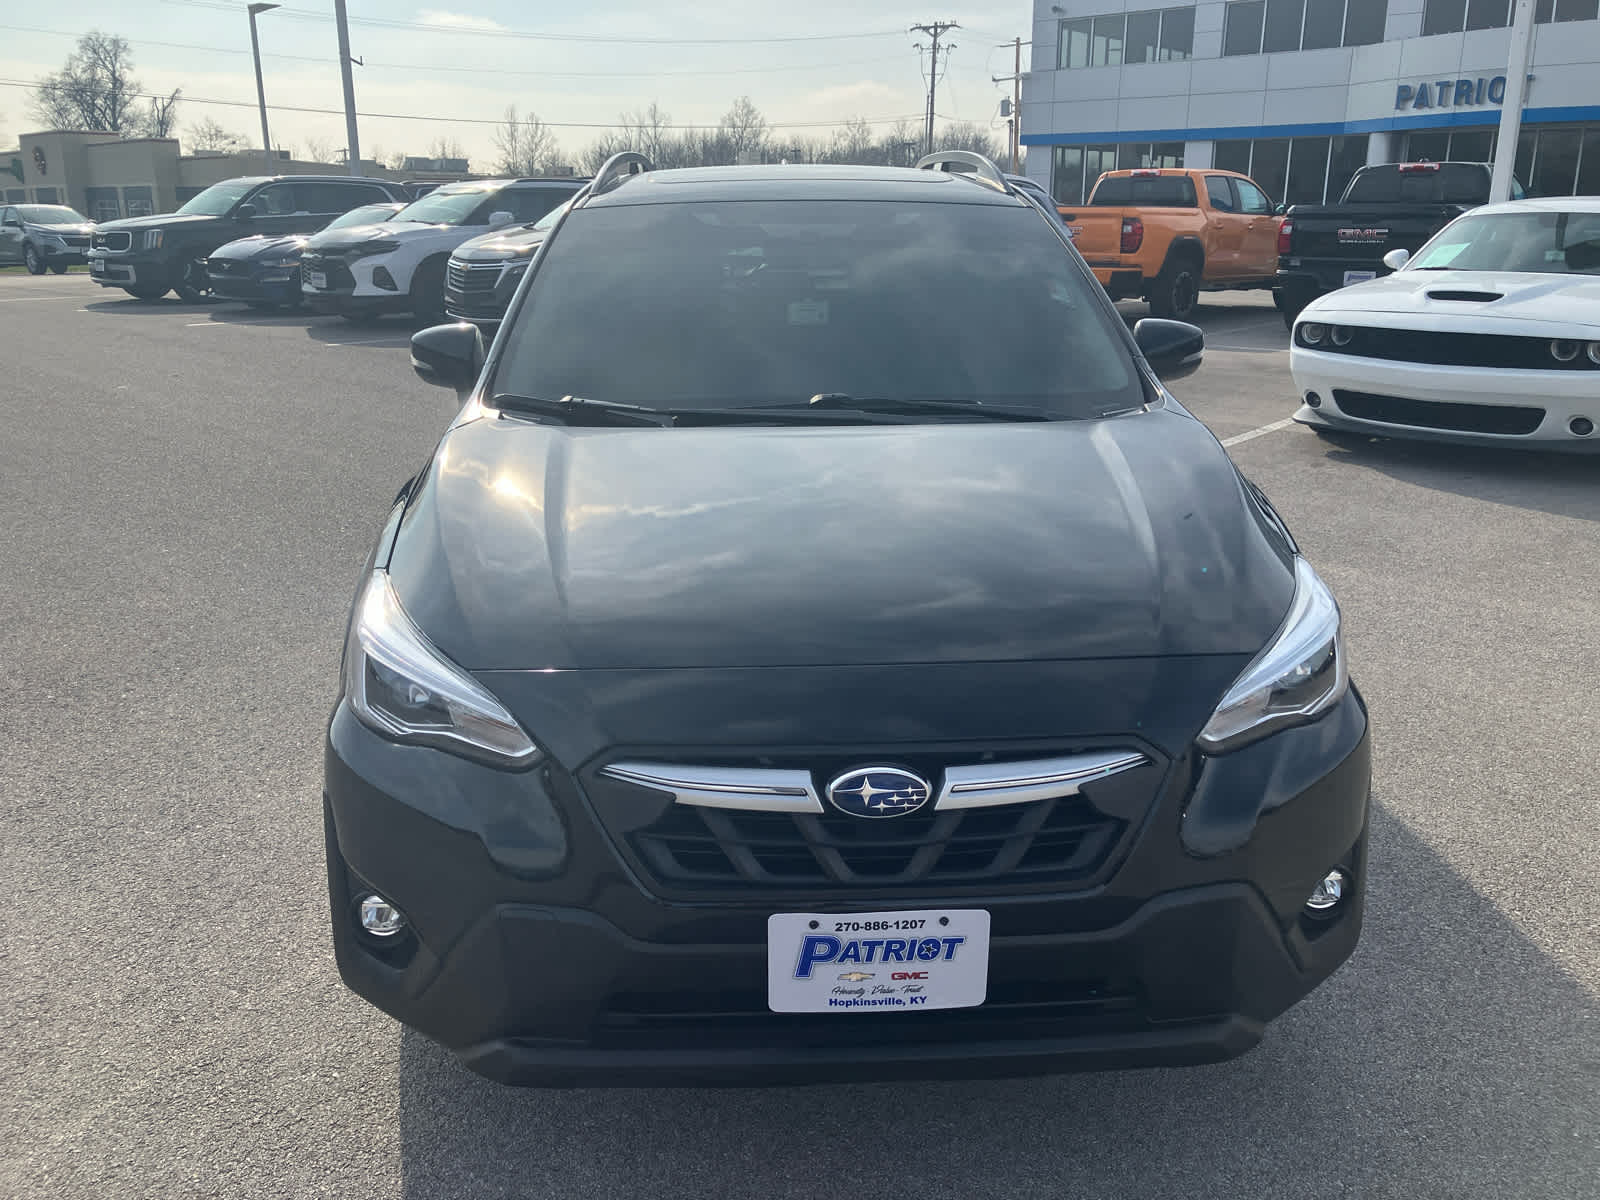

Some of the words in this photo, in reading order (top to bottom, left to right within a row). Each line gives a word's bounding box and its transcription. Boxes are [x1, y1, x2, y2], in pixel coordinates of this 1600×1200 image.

[1337, 228, 1389, 239] GMC
[834, 919, 926, 932] 270-886-1207
[793, 934, 966, 979] PATRIOT
[891, 971, 929, 981] GMC
[828, 997, 906, 1008] Hopkinsville,
[910, 996, 928, 1005] KY
